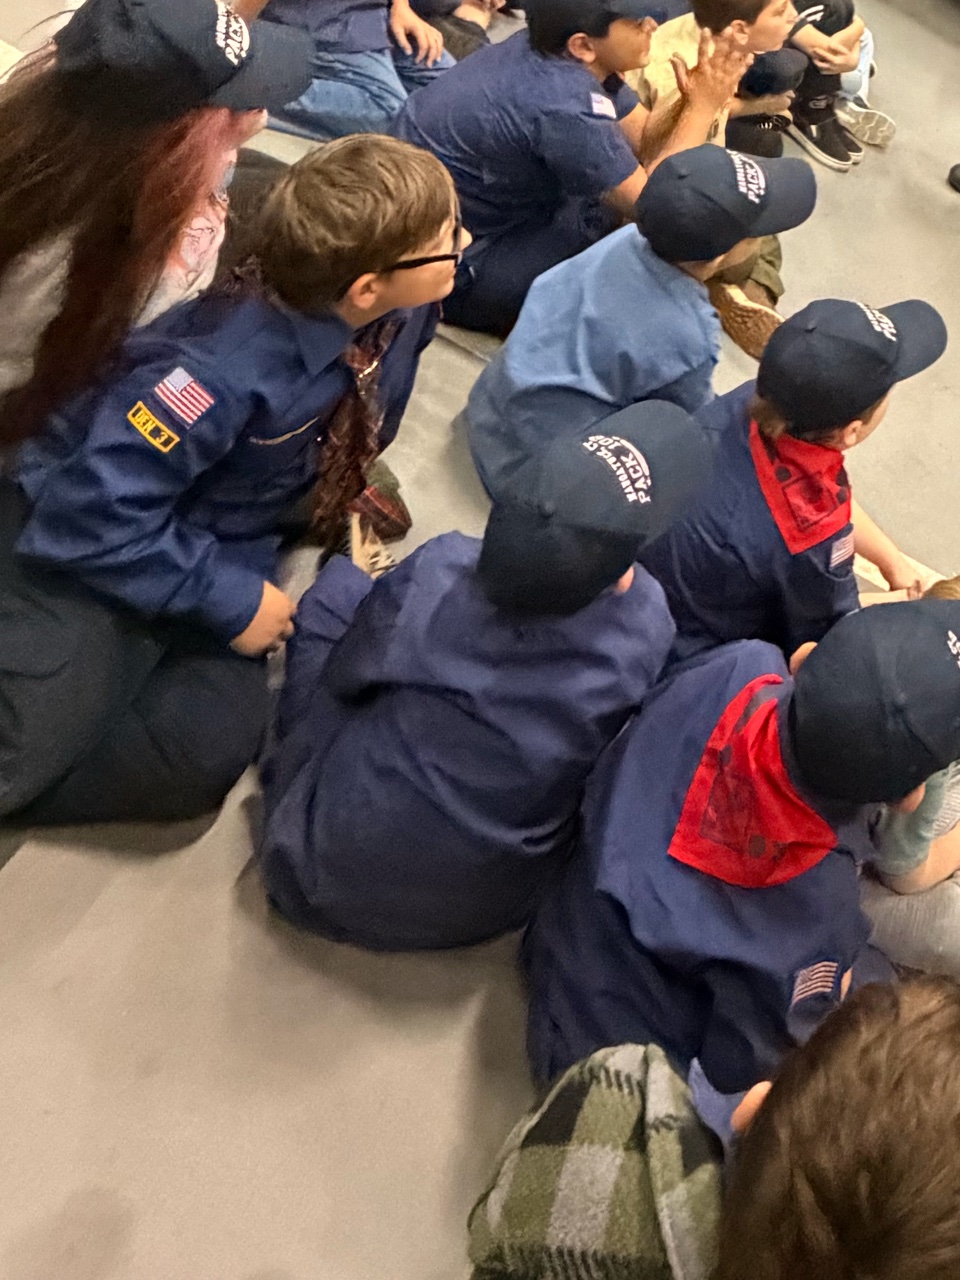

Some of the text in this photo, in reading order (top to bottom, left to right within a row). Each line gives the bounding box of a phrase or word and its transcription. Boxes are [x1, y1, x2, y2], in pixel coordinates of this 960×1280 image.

[132, 408, 170, 443] DEN 3
[620, 452, 652, 504] PACK
